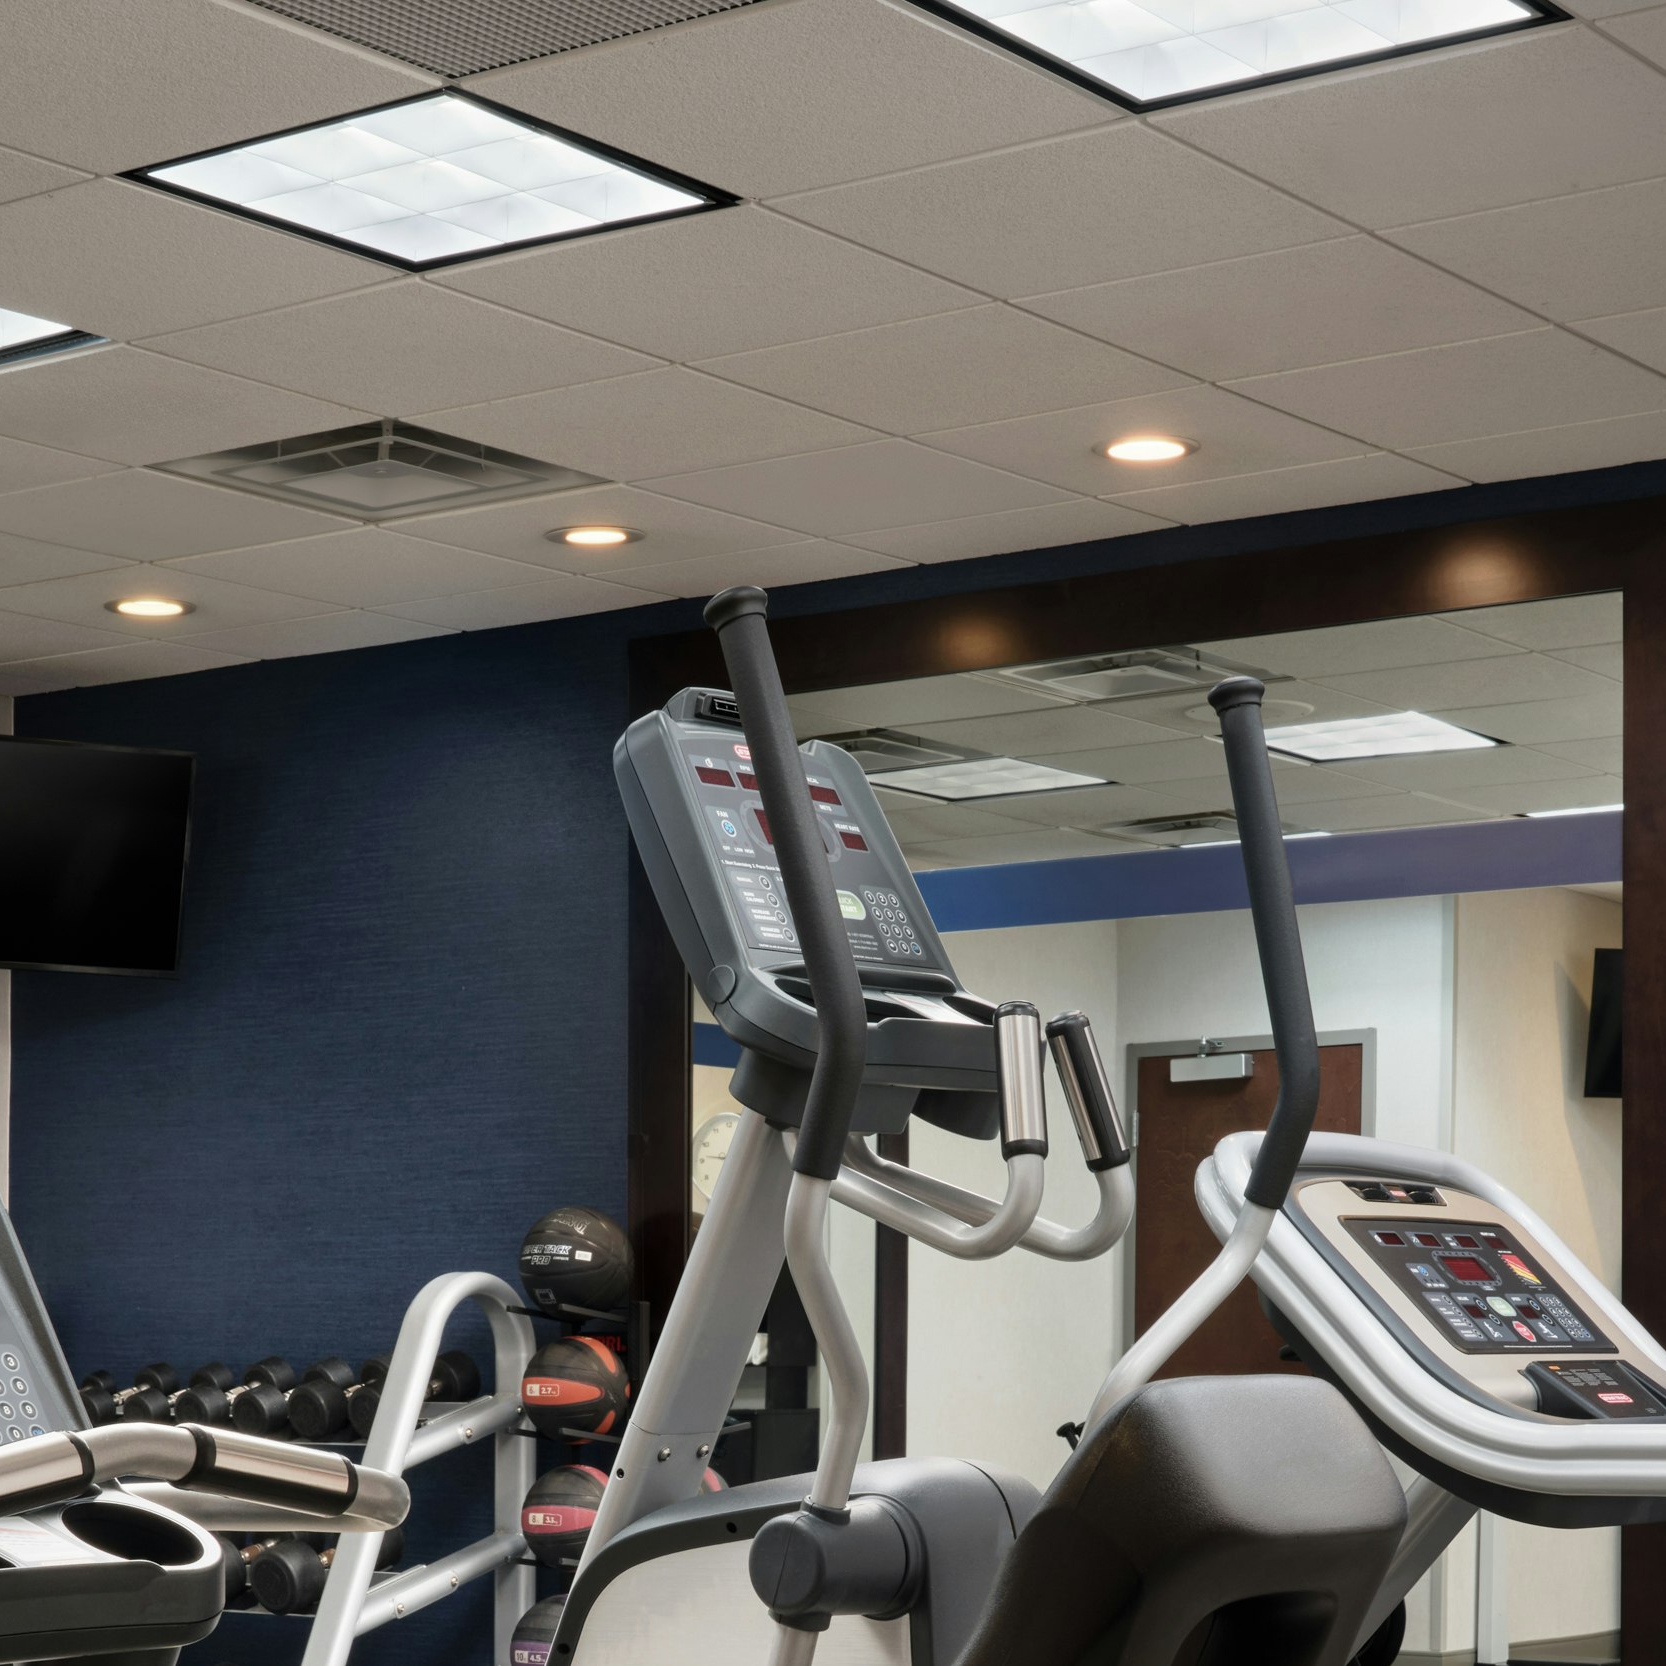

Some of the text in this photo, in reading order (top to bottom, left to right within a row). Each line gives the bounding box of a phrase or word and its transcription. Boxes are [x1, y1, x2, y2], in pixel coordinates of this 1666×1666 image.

[717, 810, 728, 818] FAN
[544, 1245, 572, 1255] TACK
[531, 1255, 551, 1265] PRO
[7, 1357, 15, 1367] 3
[17, 1381, 24, 1391] 6
[3, 1406, 11, 1415] 8
[25, 1405, 33, 1415] 9
[13, 1430, 20, 1439] 0
[532, 1515, 536, 1523] 8
[517, 1653, 541, 1663] 10 4.5
